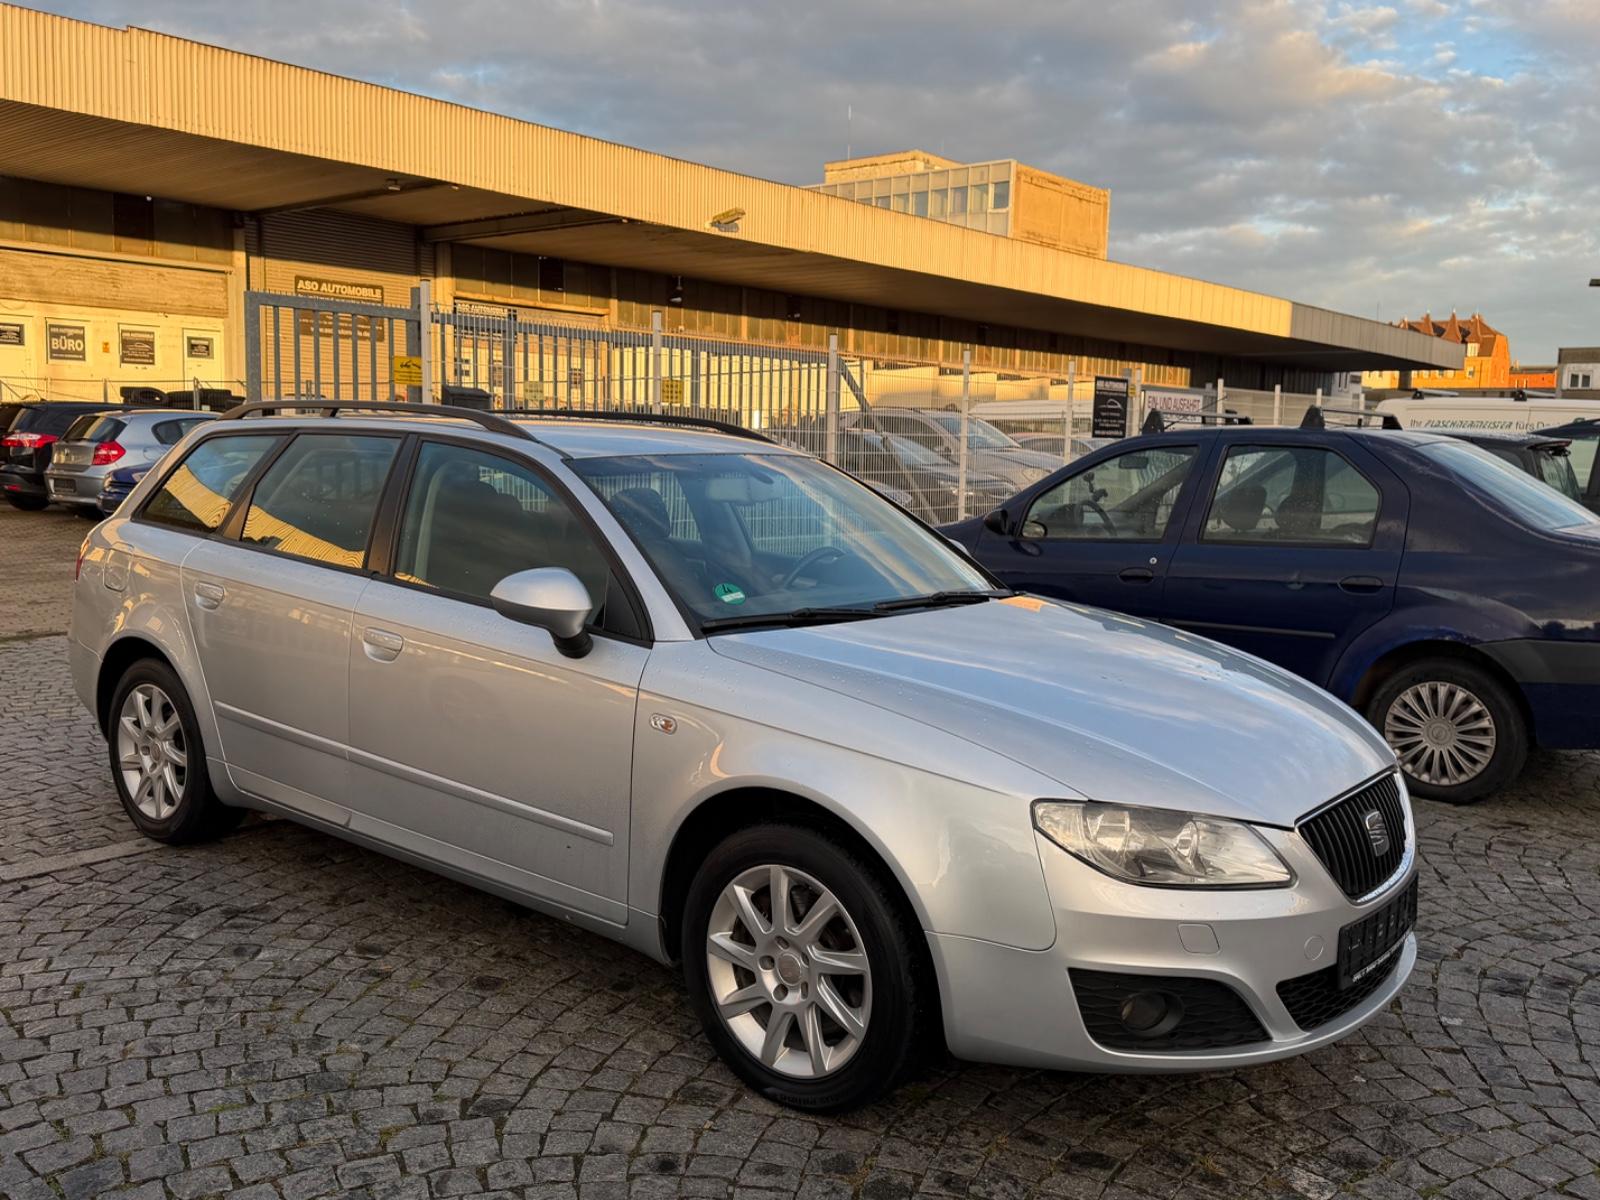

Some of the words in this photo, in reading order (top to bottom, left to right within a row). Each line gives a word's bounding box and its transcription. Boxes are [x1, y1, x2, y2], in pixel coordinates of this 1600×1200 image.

[297, 280, 319, 291] ASO
[320, 283, 382, 298] AUTOMOBILE
[51, 335, 84, 352] BÜRO
